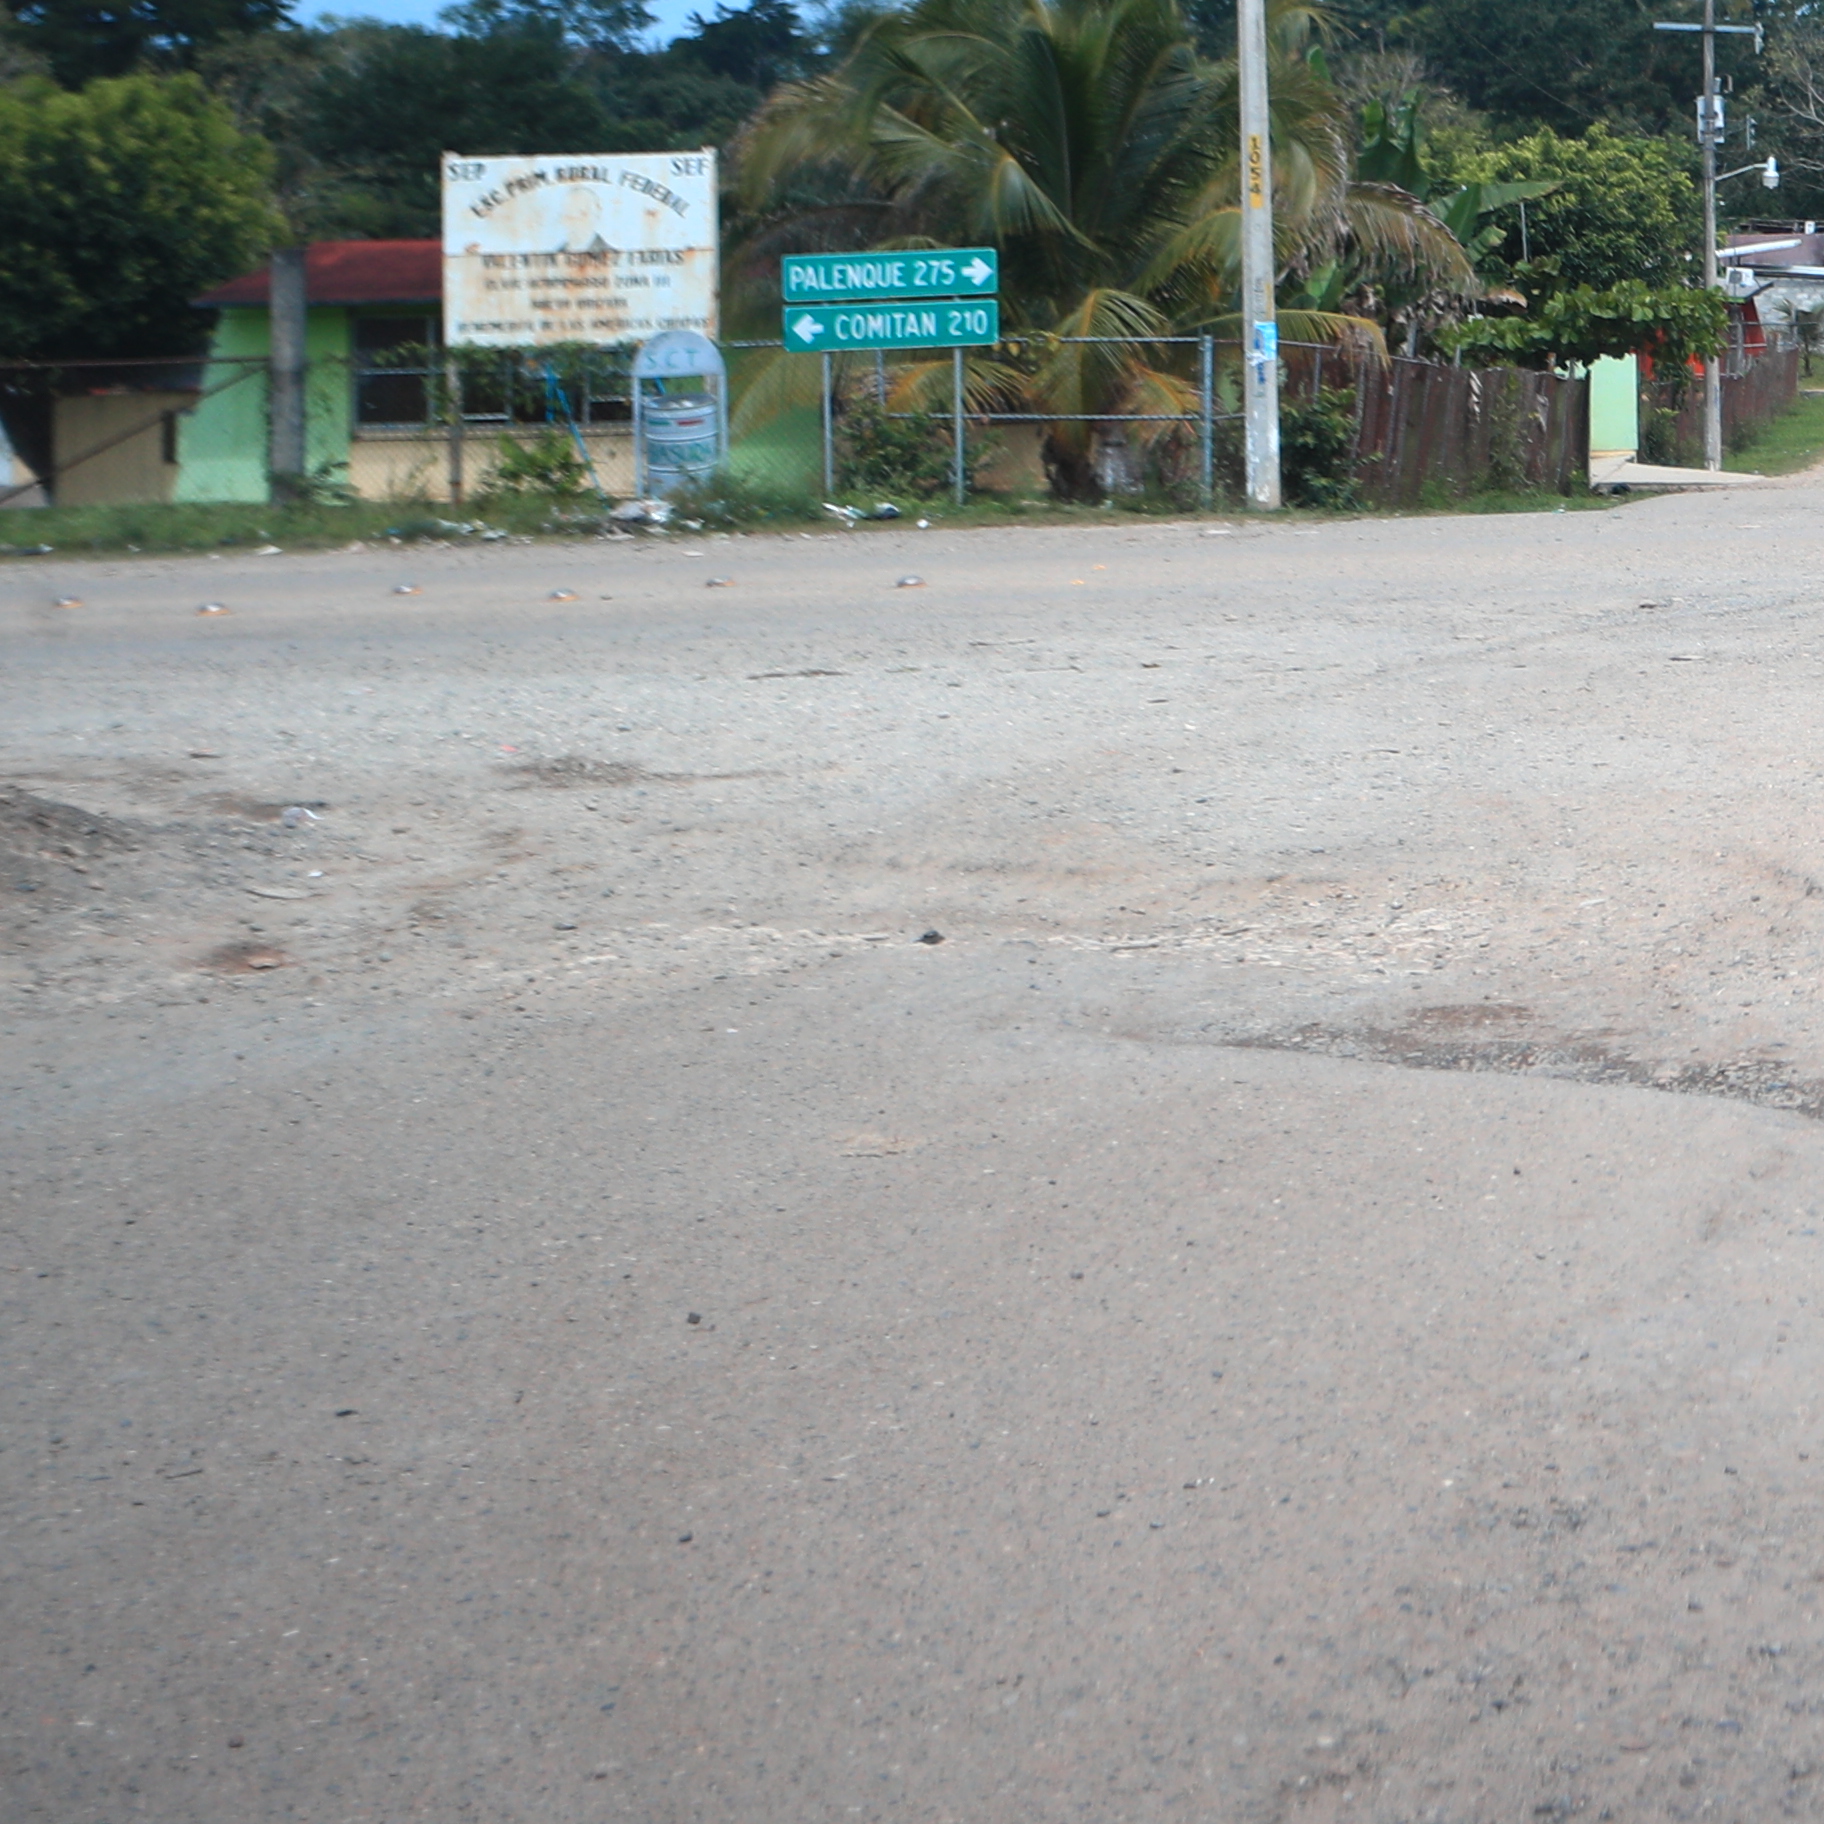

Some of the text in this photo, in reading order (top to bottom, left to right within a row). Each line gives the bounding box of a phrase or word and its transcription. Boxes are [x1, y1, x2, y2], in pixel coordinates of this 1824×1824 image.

[447, 162, 486, 182] SEP
[617, 169, 692, 219] FEDERAL
[789, 260, 955, 292] PALENQUE 275
[834, 309, 988, 340] COMITAN 210
[643, 347, 697, 369] SCT
